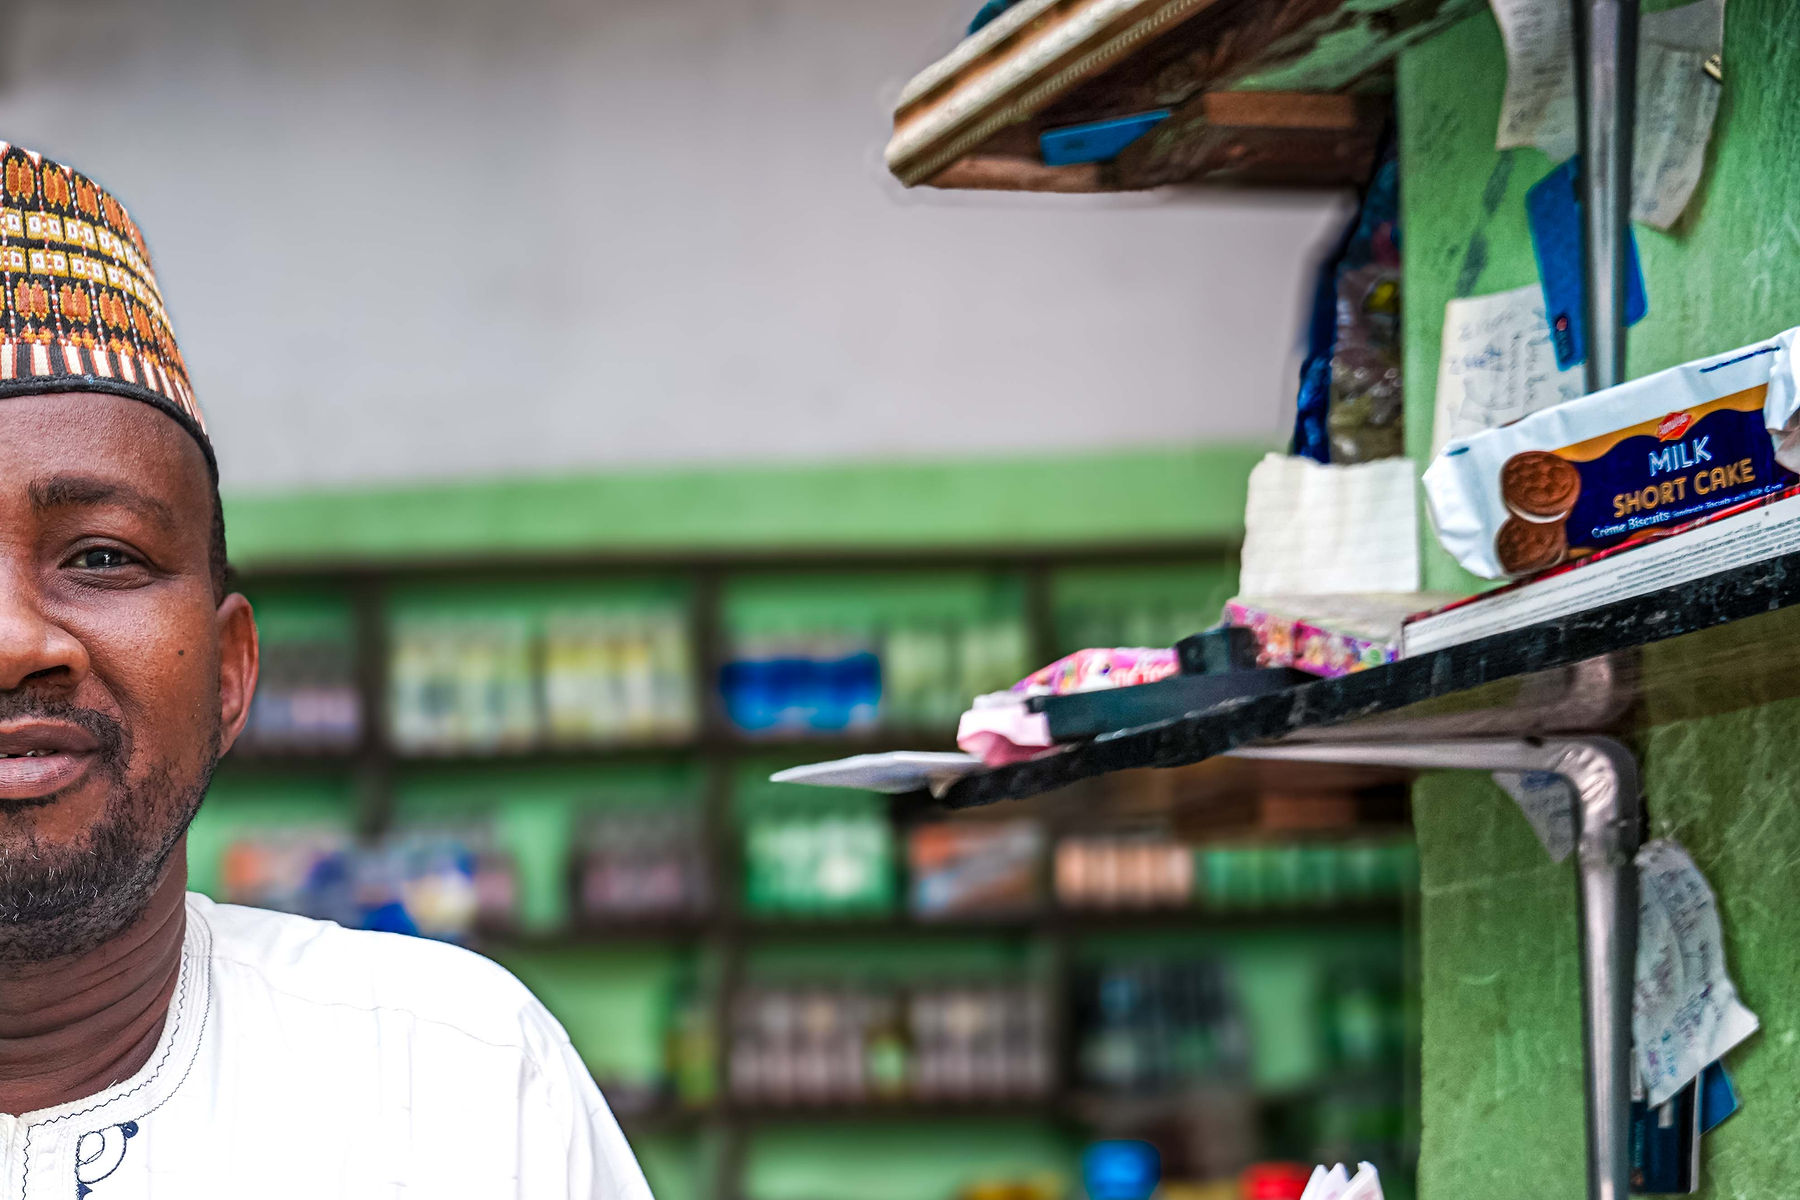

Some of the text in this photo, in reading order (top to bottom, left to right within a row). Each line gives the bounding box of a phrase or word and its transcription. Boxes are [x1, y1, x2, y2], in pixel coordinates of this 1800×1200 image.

[1648, 434, 1713, 477] MILK
[1613, 457, 1757, 518] SHORT CAKE
[1627, 511, 1671, 530] Biscuits
